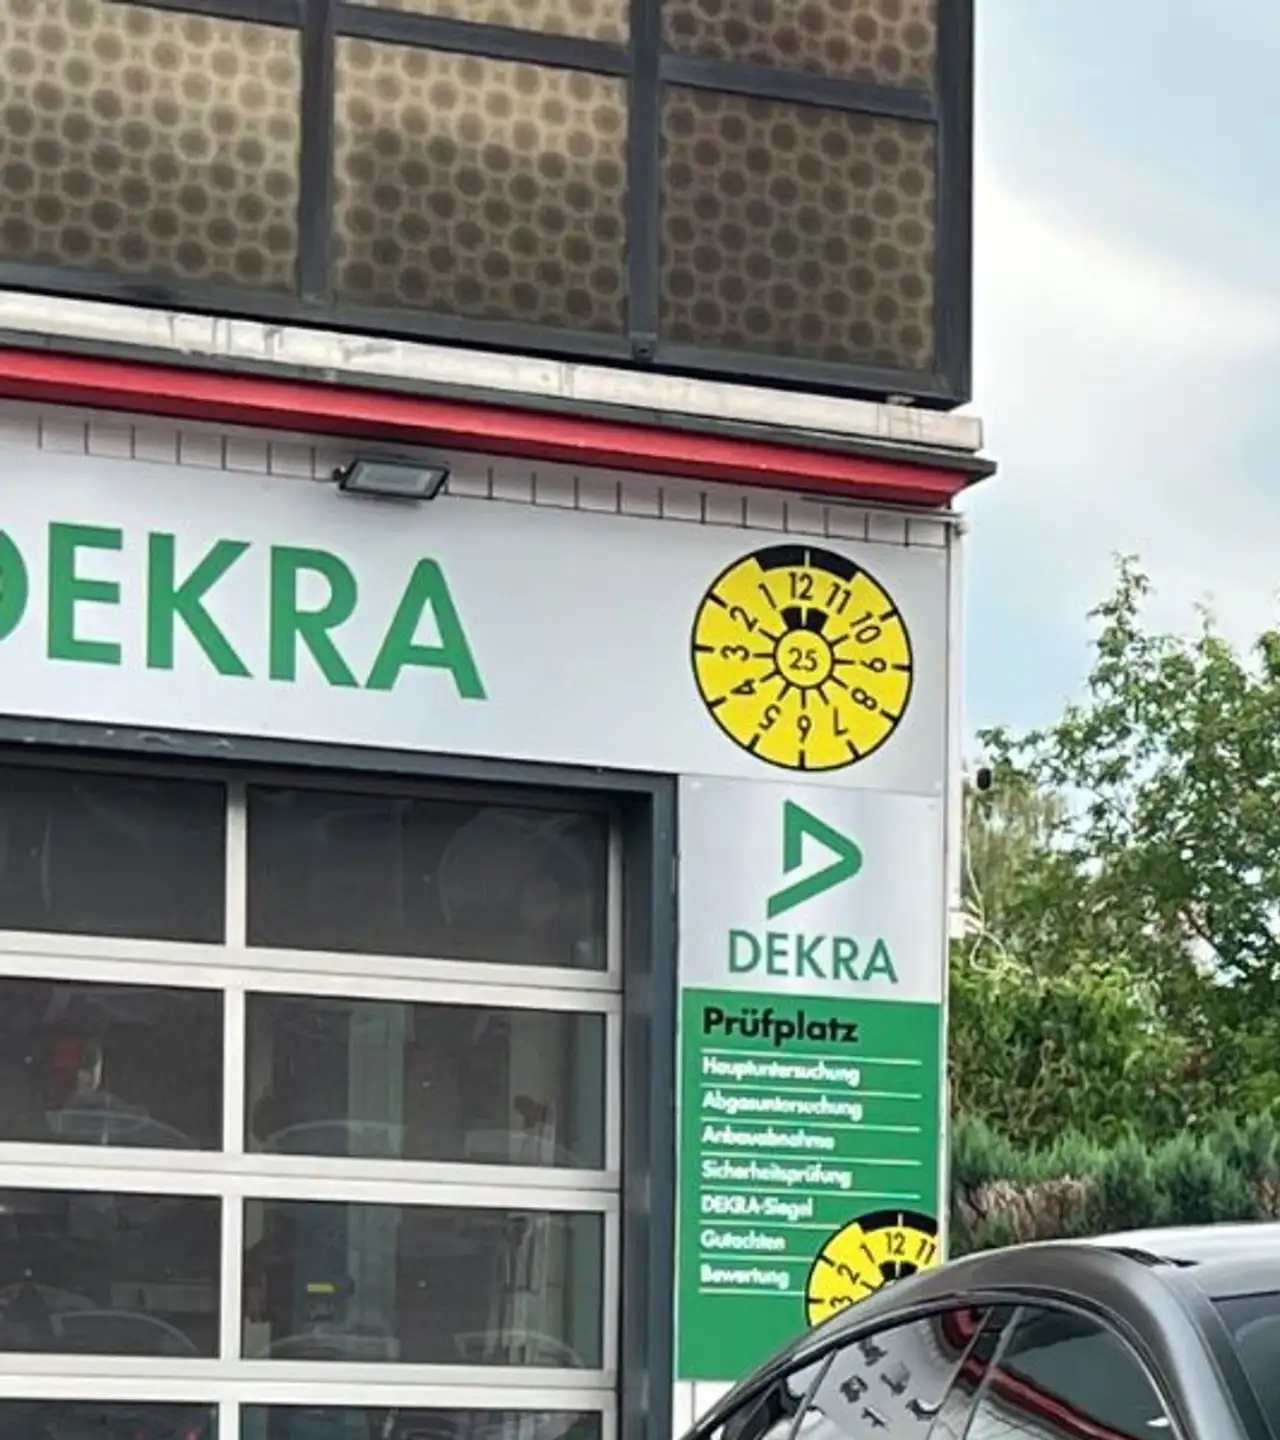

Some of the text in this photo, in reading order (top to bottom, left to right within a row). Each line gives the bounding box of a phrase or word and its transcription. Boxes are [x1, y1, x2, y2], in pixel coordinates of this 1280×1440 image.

[758, 583, 777, 610] 1
[788, 571, 814, 601] 12
[826, 581, 853, 615] 11
[729, 606, 760, 632] 2
[849, 611, 882, 644] 10
[720, 645, 750, 662] 3
[788, 647, 818, 672] 25
[730, 679, 757, 696] 4
[851, 687, 878, 711] 8
[758, 703, 782, 731] 5
[833, 707, 848, 736] 7
[728, 928, 899, 985] DEKRA
[703, 1006, 859, 1047] Prüfplatz
[702, 1055, 861, 1087] Hauptuntersuchung
[702, 1089, 863, 1122] Abgasuntersuchung
[701, 1158, 853, 1189] Sicherheitsprüfung
[701, 1195, 814, 1222] DEKRA-Siegel
[701, 1229, 787, 1251] Gutachten
[860, 1243, 876, 1264] 1
[884, 1230, 906, 1256] 12
[915, 1238, 937, 1265] 11
[700, 1262, 790, 1290] Bewertung
[836, 1261, 861, 1285] 2
